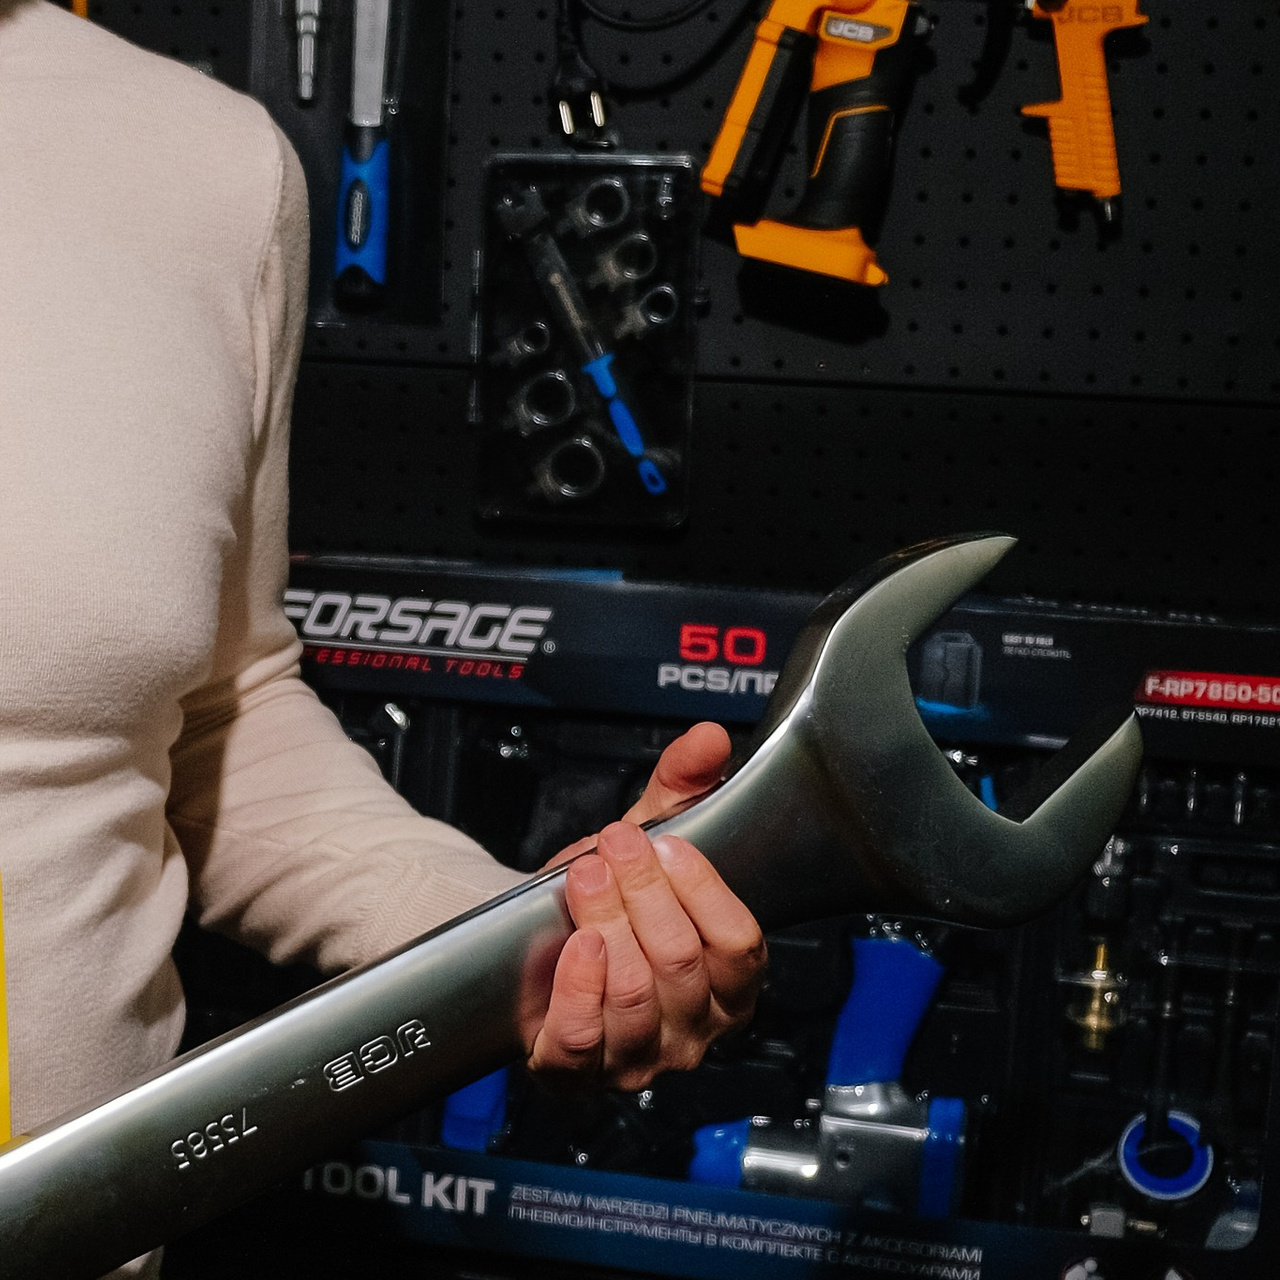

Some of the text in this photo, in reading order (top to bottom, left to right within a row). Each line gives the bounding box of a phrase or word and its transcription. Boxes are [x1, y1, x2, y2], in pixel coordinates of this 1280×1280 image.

[828, 20, 874, 42] JCB
[679, 623, 767, 665] 50
[444, 659, 525, 680] TOOLS
[322, 1019, 432, 1091] JCB
[171, 1108, 258, 1170] 75585
[422, 1171, 495, 1214] KIT
[510, 1183, 581, 1208] ZESTAW
[672, 1207, 842, 1243] PNEUMATYCZNYCH
[508, 1205, 702, 1244] ПНЕВМОИНСТРУМЕНТЫ
[720, 1235, 822, 1262] КОМПЛЕКТЕ
